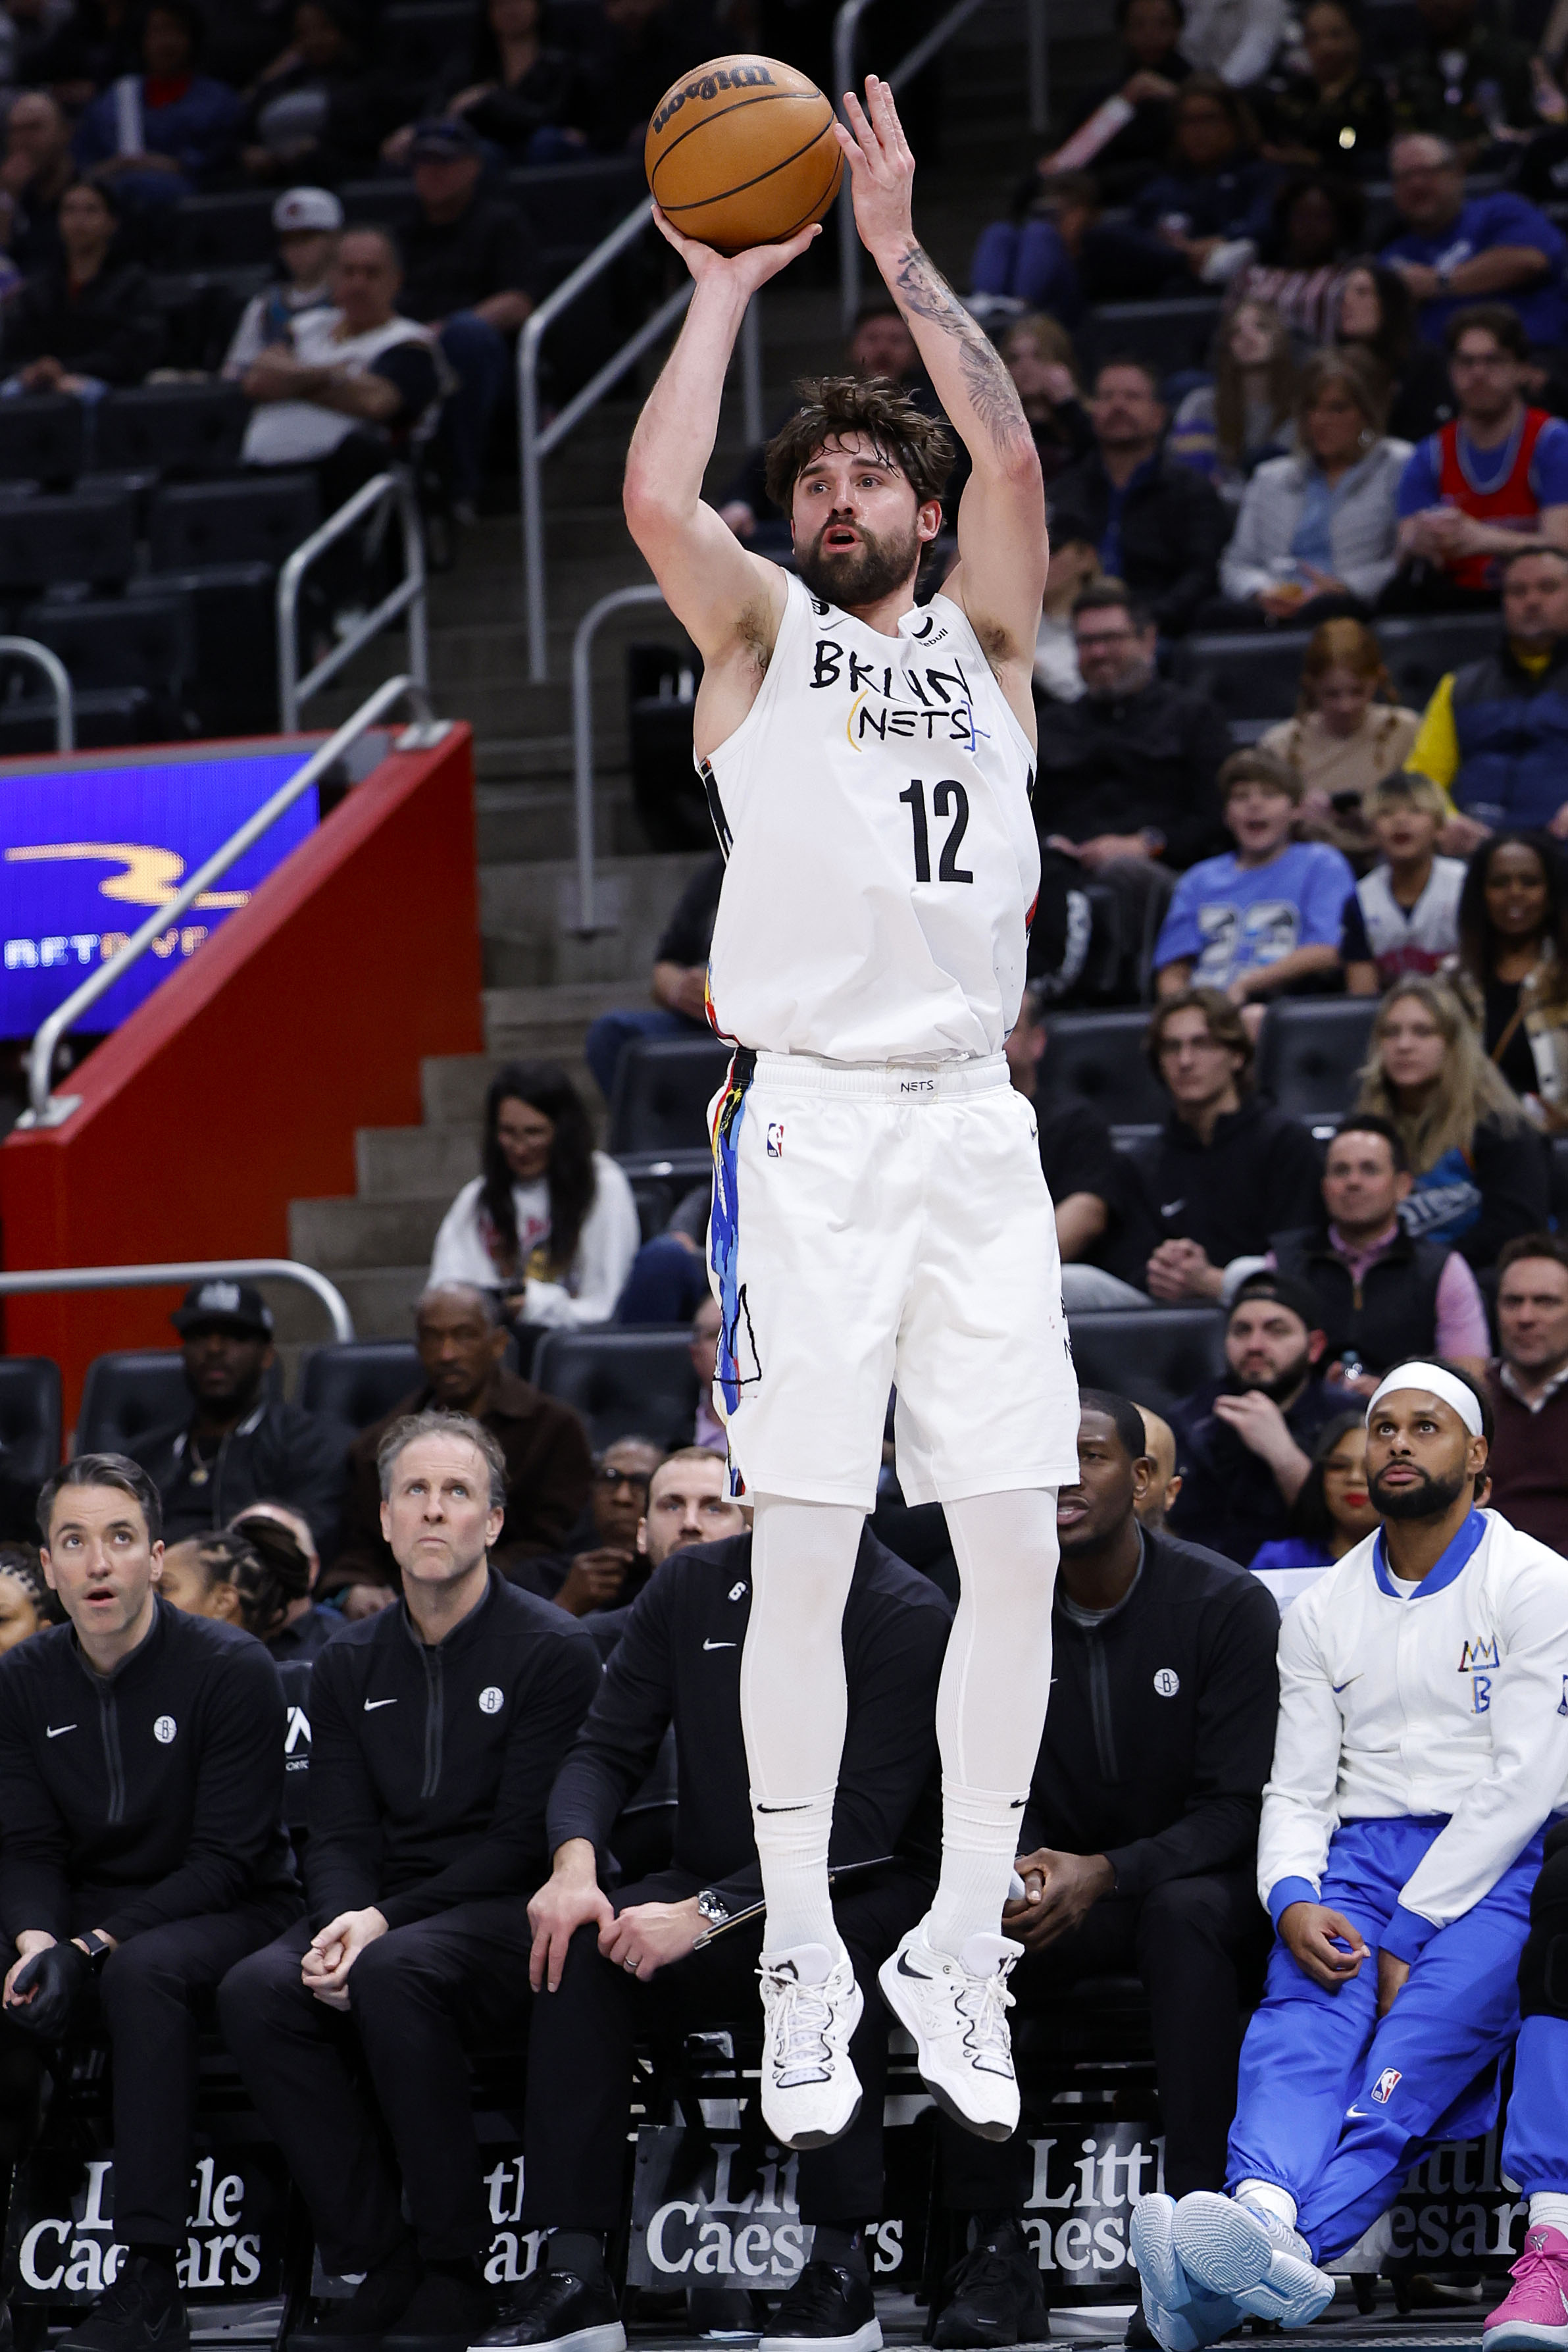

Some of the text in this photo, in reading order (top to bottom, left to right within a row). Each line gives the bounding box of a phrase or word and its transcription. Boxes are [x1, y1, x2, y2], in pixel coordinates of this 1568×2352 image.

[653, 65, 776, 134] Wilson
[917, 628, 948, 648] ebull
[858, 706, 971, 740] NETS
[899, 779, 973, 884] 12
[900, 1080, 934, 1092] NETS
[1471, 1675, 1492, 1714] B
[76, 2157, 245, 2230] Lle
[1023, 2136, 1166, 2209] Littl
[19, 2218, 261, 2290] Caears
[646, 2201, 903, 2276] Caess
